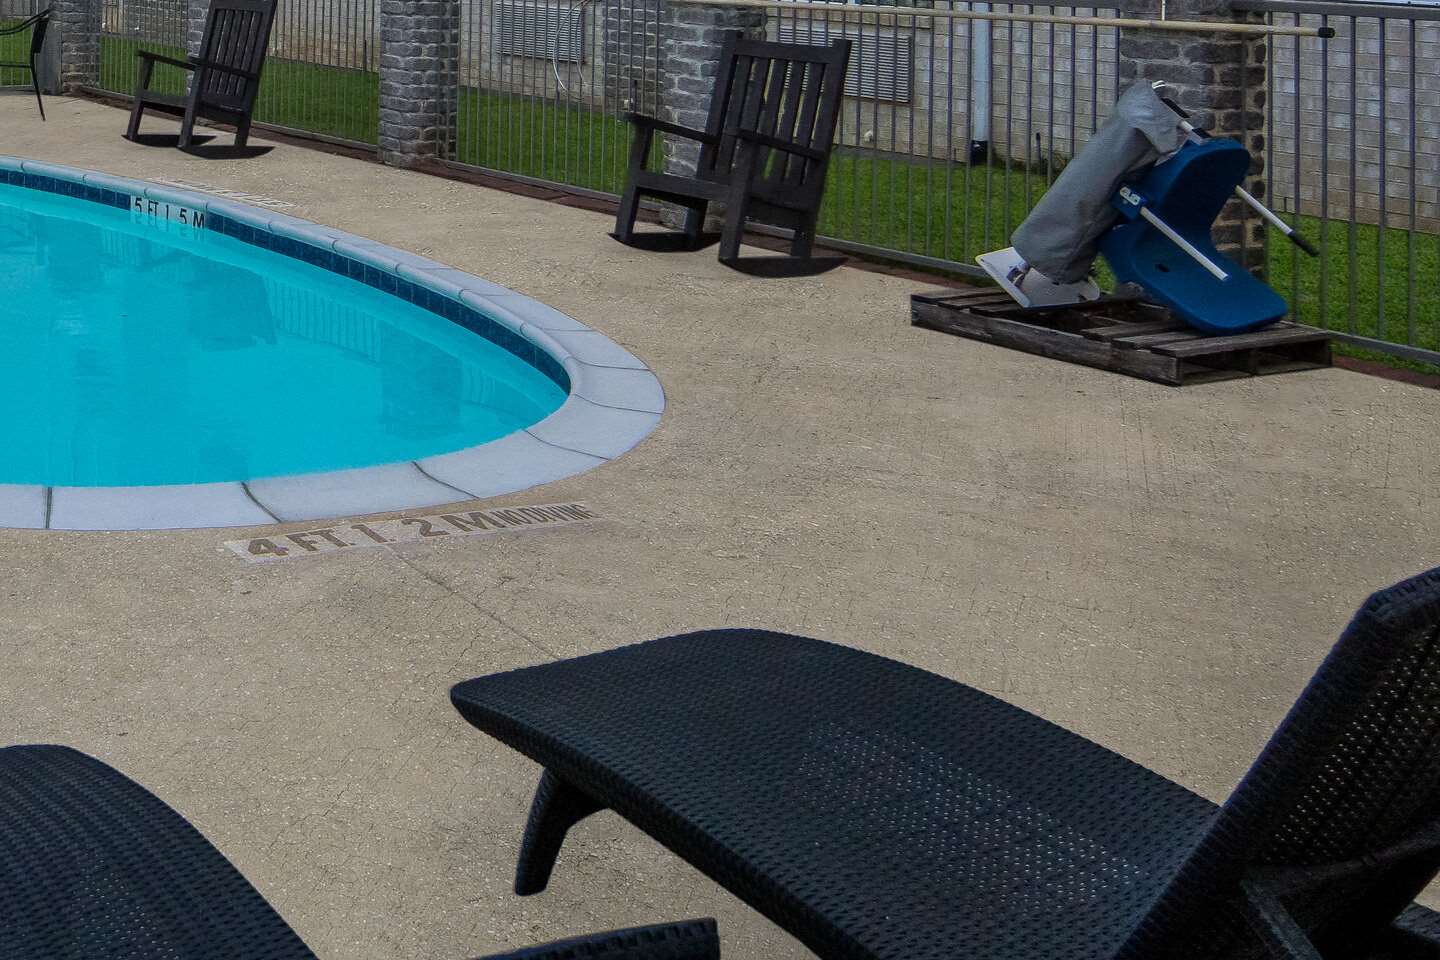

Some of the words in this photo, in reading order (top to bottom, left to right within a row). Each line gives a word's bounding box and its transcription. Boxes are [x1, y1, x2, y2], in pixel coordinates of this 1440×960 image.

[134, 197, 142, 213] 5
[147, 200, 159, 217] FT
[179, 208, 188, 225] 5
[192, 212, 205, 229] M
[440, 511, 507, 532] M
